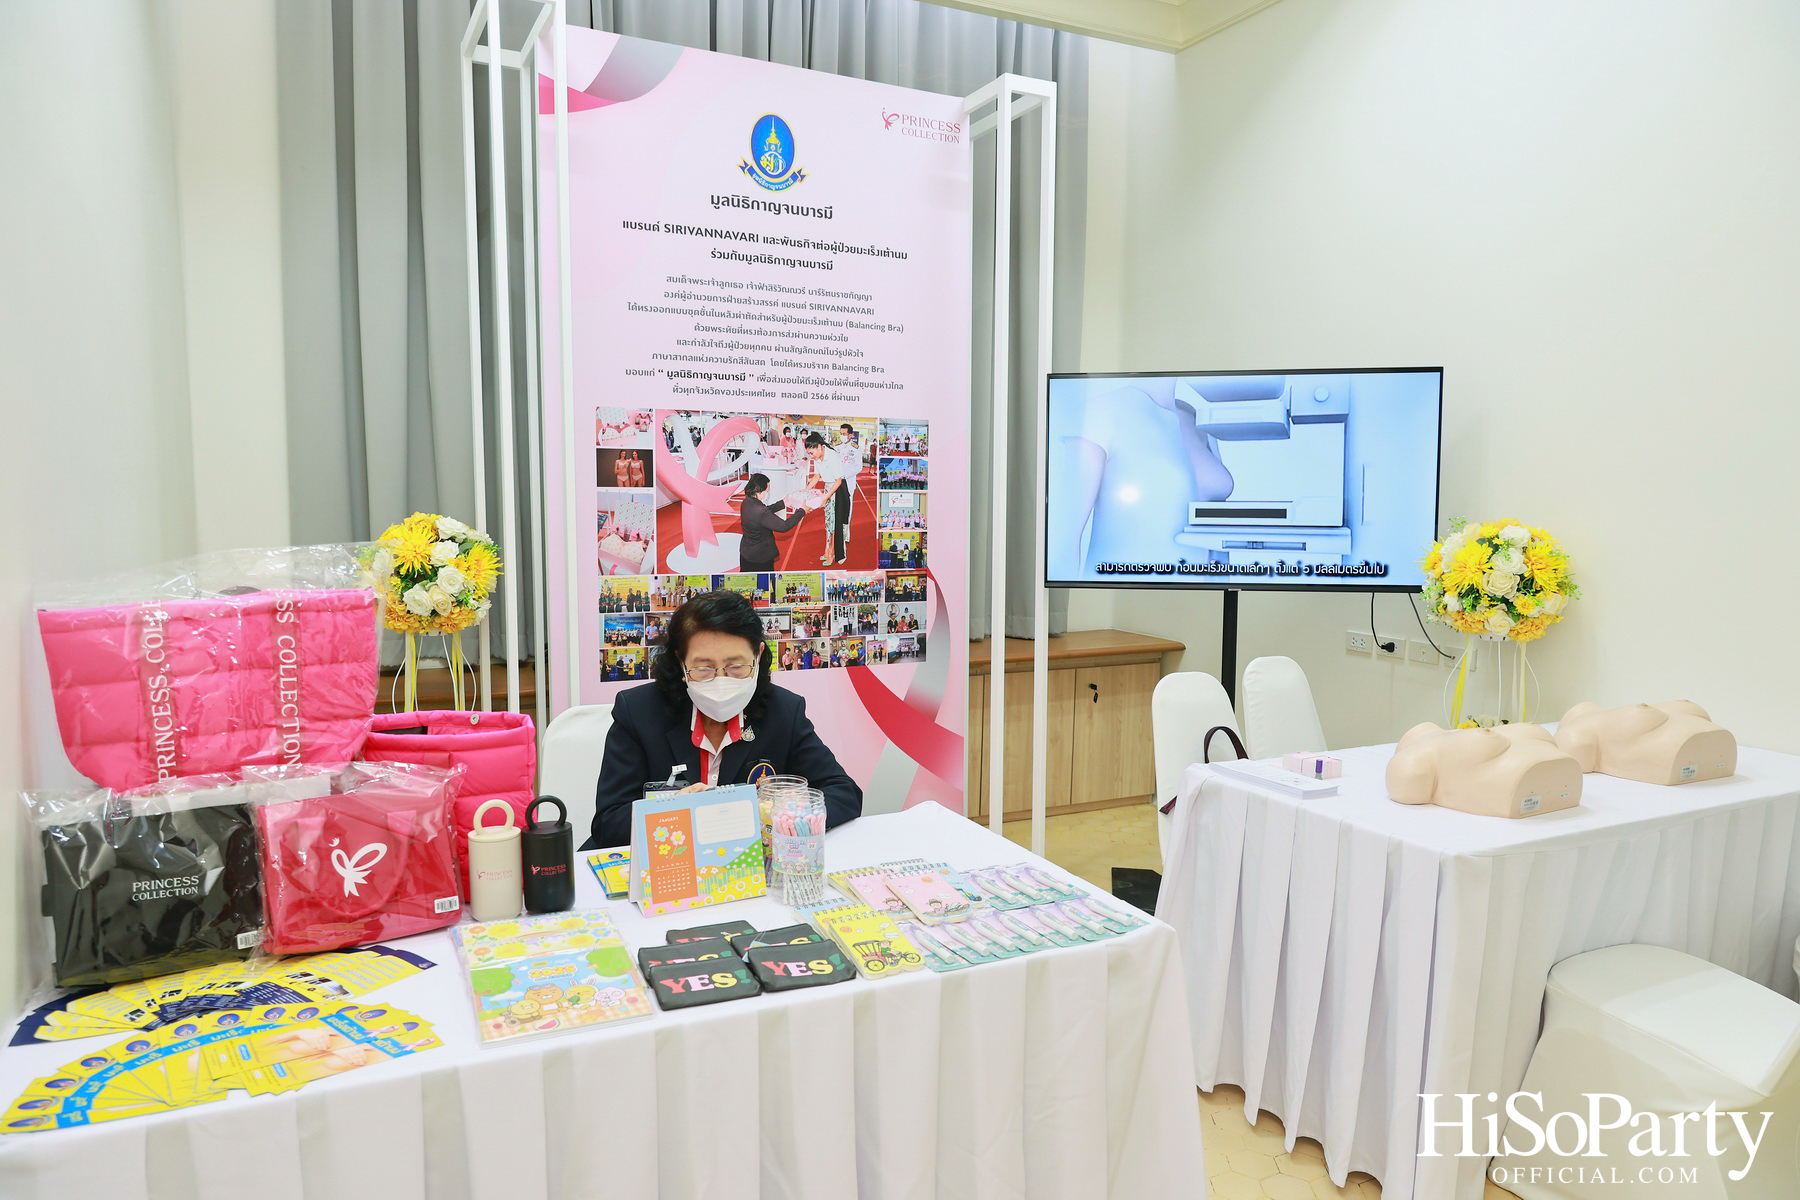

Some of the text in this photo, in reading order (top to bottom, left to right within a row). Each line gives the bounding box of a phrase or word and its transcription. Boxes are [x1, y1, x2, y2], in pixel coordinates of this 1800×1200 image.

[902, 113, 961, 134] PRINCESS
[901, 127, 960, 144] COLLECTION
[710, 194, 833, 220] มูลนิธิกาญจนบารมี
[622, 220, 908, 260] แบรนด์ SIRIVANNAVARI และพันธกิจต่อผู้ป่วยมะเร็งเต้านม
[710, 247, 833, 271] ร่วมกับมูลนิธิกาญจนบารมี
[809, 302, 875, 316] SIRIVANNAVARI
[845, 319, 886, 333] (Balancing
[887, 323, 904, 334] Bra)
[666, 369, 746, 382] มูลนิธิกาญจนบารมี
[831, 362, 869, 374] Balancing
[871, 365, 885, 374] Bra
[811, 392, 829, 401] 2566
[277, 634, 303, 770] COLLECTION
[148, 674, 177, 784] PRINCESS
[541, 864, 566, 872] PRINCESS
[132, 875, 200, 892] PRINCESS
[132, 886, 199, 902] COLLECTION
[761, 953, 846, 977] YES!
[659, 969, 752, 994] YES!
